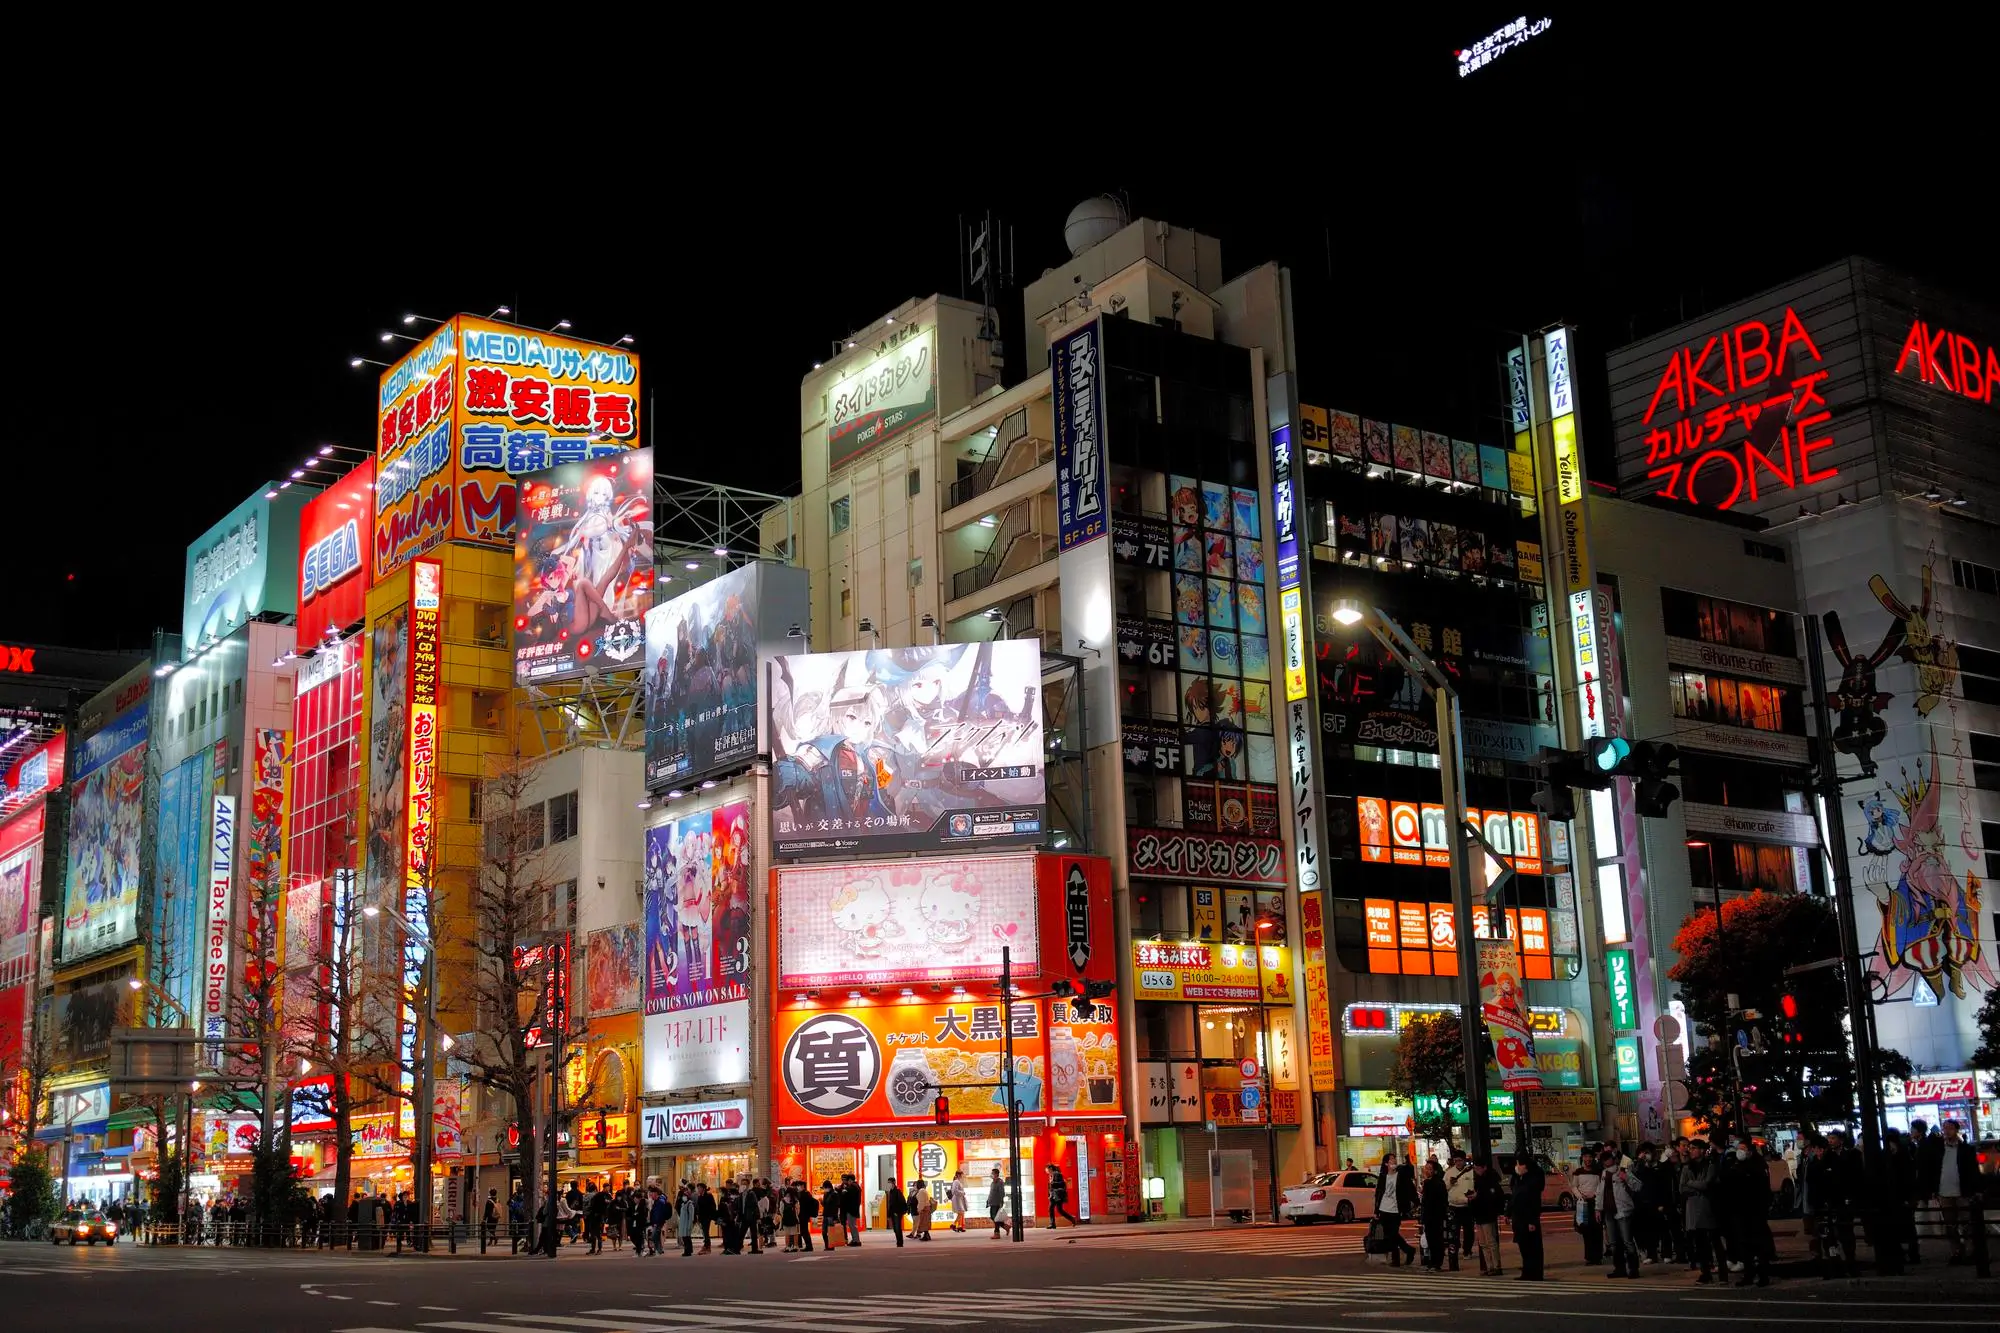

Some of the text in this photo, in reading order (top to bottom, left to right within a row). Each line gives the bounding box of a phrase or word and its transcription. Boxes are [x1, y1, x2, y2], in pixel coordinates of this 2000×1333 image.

[1459, 17, 1552, 77] 秋葉原ファーストビル
[1472, 16, 1527, 56] 住友不動産
[463, 330, 635, 384] MEDIAリサイクル
[1642, 306, 1823, 425] AKIBA
[834, 347, 927, 424] メイドカジノ
[1550, 337, 1567, 409] スーパービル
[466, 367, 635, 436] 激安販売
[1302, 419, 1328, 442] 8F
[1644, 370, 1829, 465] カルチャーズ
[377, 483, 452, 575] Mulan
[1559, 453, 1580, 584] Yellow Submarine
[303, 518, 360, 602] SEGA
[1145, 544, 1169, 566] 7F
[1518, 550, 1541, 561] GAME
[1286, 596, 1297, 607] 3F
[1575, 592, 1586, 604] 5F
[417, 610, 437, 621] DVD
[419, 643, 433, 652] CD
[1149, 643, 1174, 665] 6F
[414, 662, 436, 673] アニメ
[1323, 713, 1346, 733] 5F
[1154, 747, 1180, 769] 5F
[969, 767, 1031, 780] イベント始動
[411, 711, 434, 872] お売り下さい
[215, 800, 232, 859] AKKY
[1189, 810, 1213, 822] Stars
[1295, 765, 1316, 866] ルノアール
[1134, 835, 1280, 879] メイドカジノ
[1198, 892, 1211, 904] 3F
[207, 876, 230, 960] Tax-free
[1195, 908, 1216, 921] 入口
[1371, 919, 1388, 931] Tax
[1369, 931, 1392, 943] Free
[666, 951, 679, 986] 2
[735, 936, 749, 973] 3
[1138, 948, 1208, 966] 全身もみほぐし
[206, 967, 227, 1014] Shop
[1144, 974, 1173, 986] りらくる
[1317, 965, 1326, 1002] TAX
[1611, 957, 1630, 1025] リバティー
[647, 984, 746, 1013] COMICS NOW ON SALE
[935, 1003, 1039, 1043] 大黒屋
[1320, 1008, 1331, 1055] FREE
[887, 1032, 929, 1046] チケット
[794, 1028, 869, 1105] 質
[1243, 1063, 1255, 1073] 40
[1150, 1095, 1198, 1107] ルノアール
[1245, 1092, 1254, 1107] P
[1273, 1092, 1295, 1109] FREE
[645, 1109, 670, 1141] ZIN
[673, 1112, 726, 1132] COMIC ZIN
